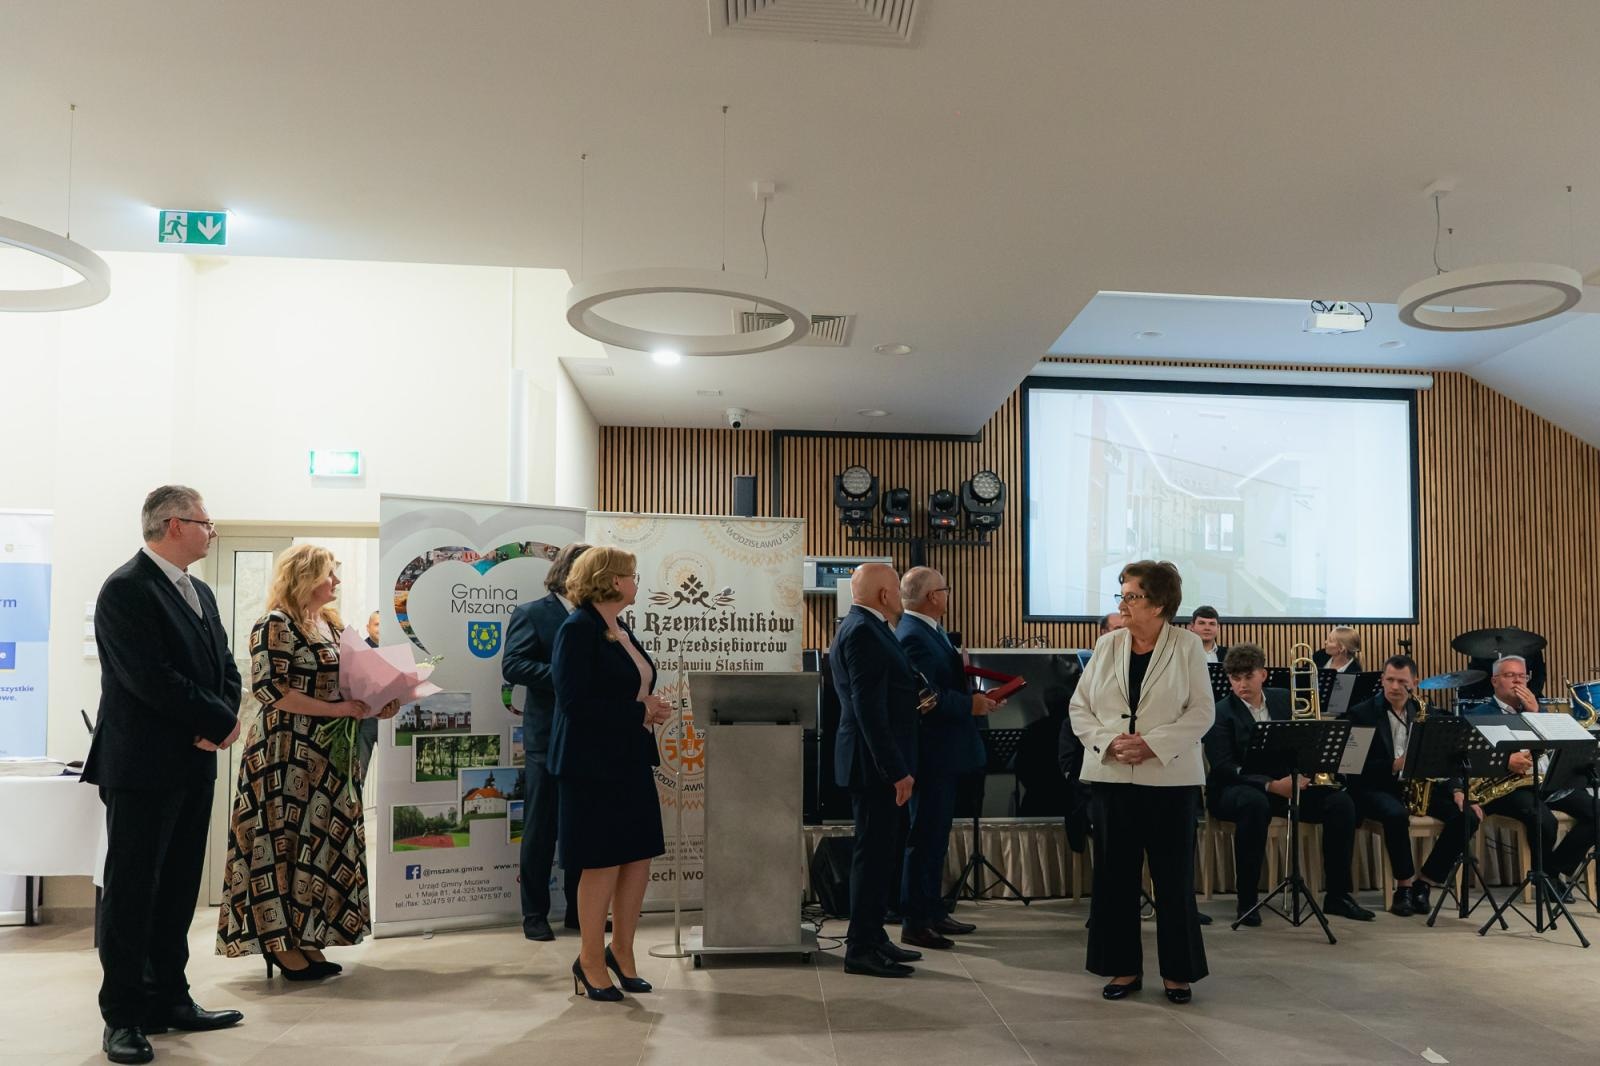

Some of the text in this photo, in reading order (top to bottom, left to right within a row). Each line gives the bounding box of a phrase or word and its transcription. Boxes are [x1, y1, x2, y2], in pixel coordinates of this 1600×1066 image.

[451, 583, 518, 600] Gmina
[643, 609, 795, 636] Rzemieślników
[654, 657, 712, 671] dzisawiu
[441, 880, 463, 888] Gminy
[464, 878, 490, 886] Mszana
[477, 885, 503, 893] Mszana
